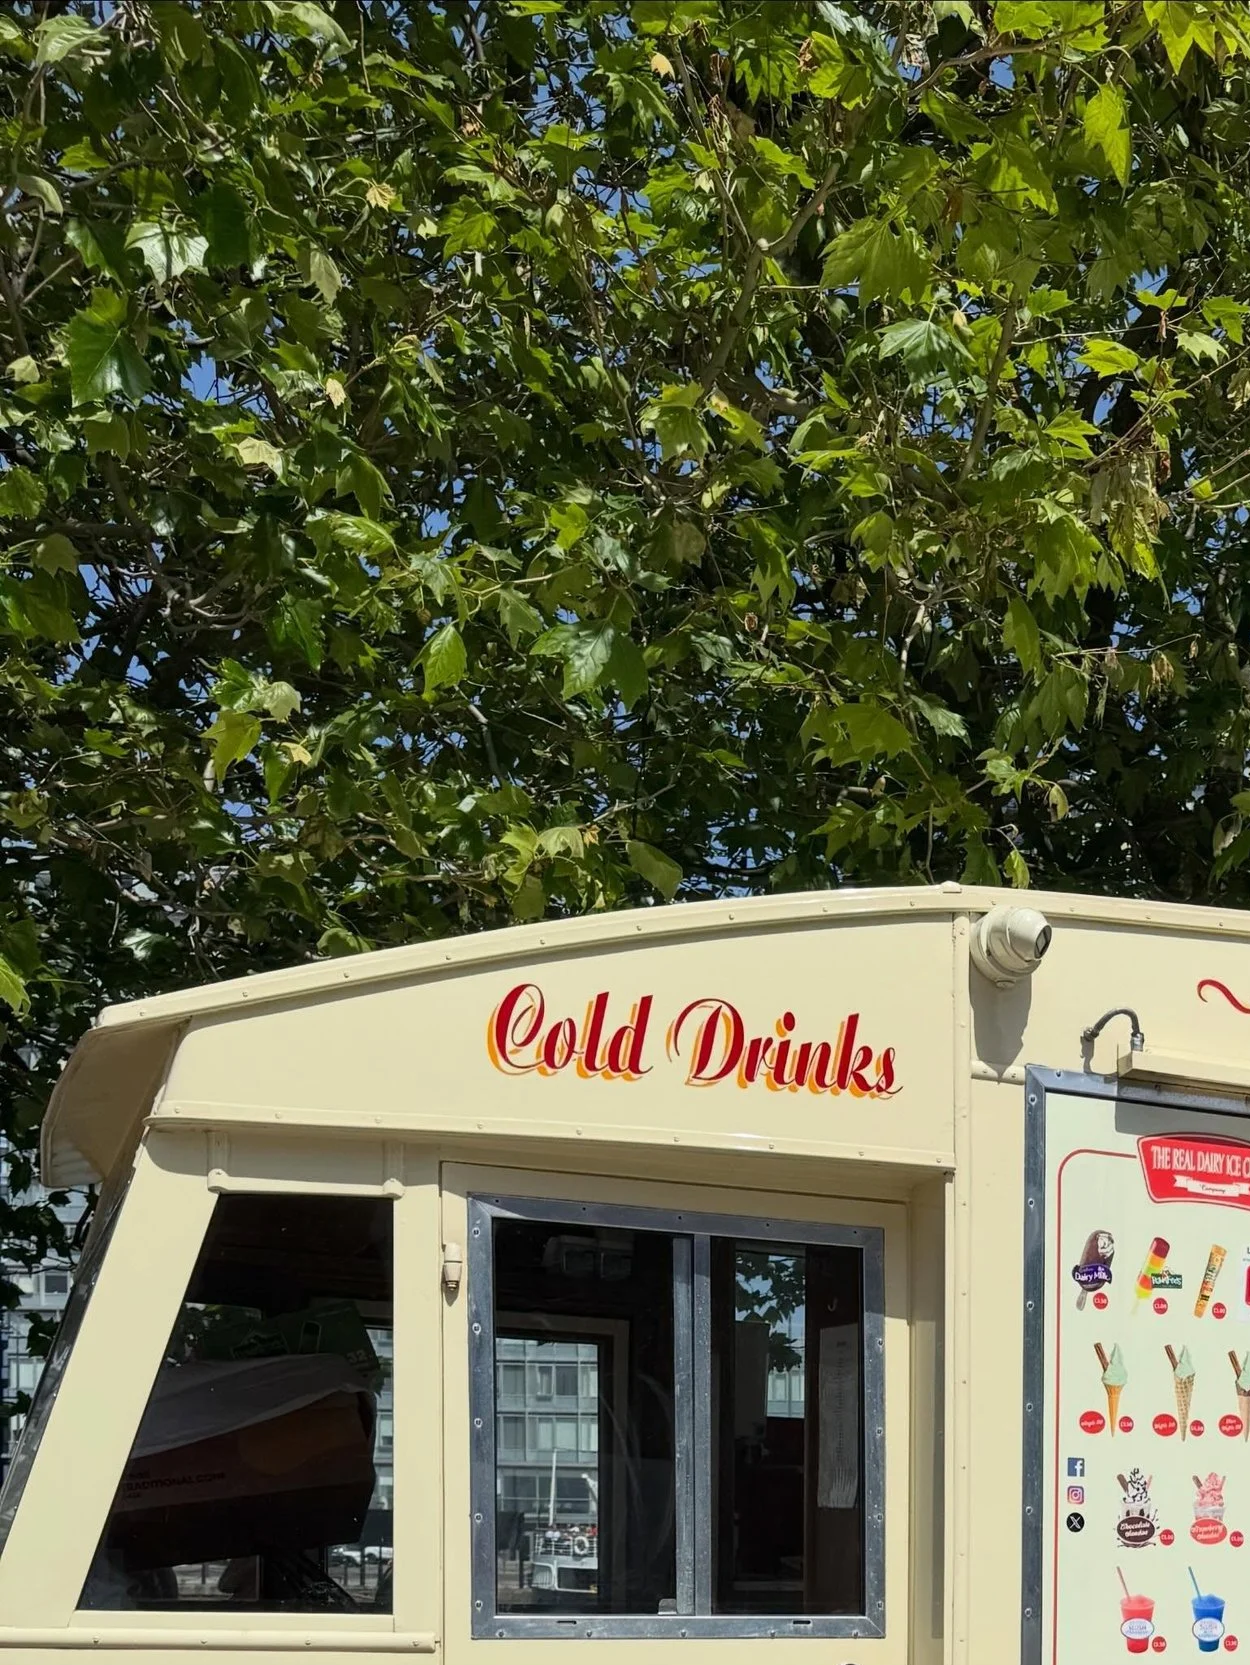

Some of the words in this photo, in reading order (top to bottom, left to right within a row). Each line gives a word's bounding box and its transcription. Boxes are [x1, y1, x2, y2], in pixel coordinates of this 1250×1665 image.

[487, 983, 654, 1081] Cold
[666, 998, 904, 1099] Drinks
[1151, 1145, 1171, 1170] THE
[1172, 1148, 1196, 1172] REAL
[1197, 1151, 1226, 1175] DAIRY
[1226, 1154, 1242, 1177] ICE
